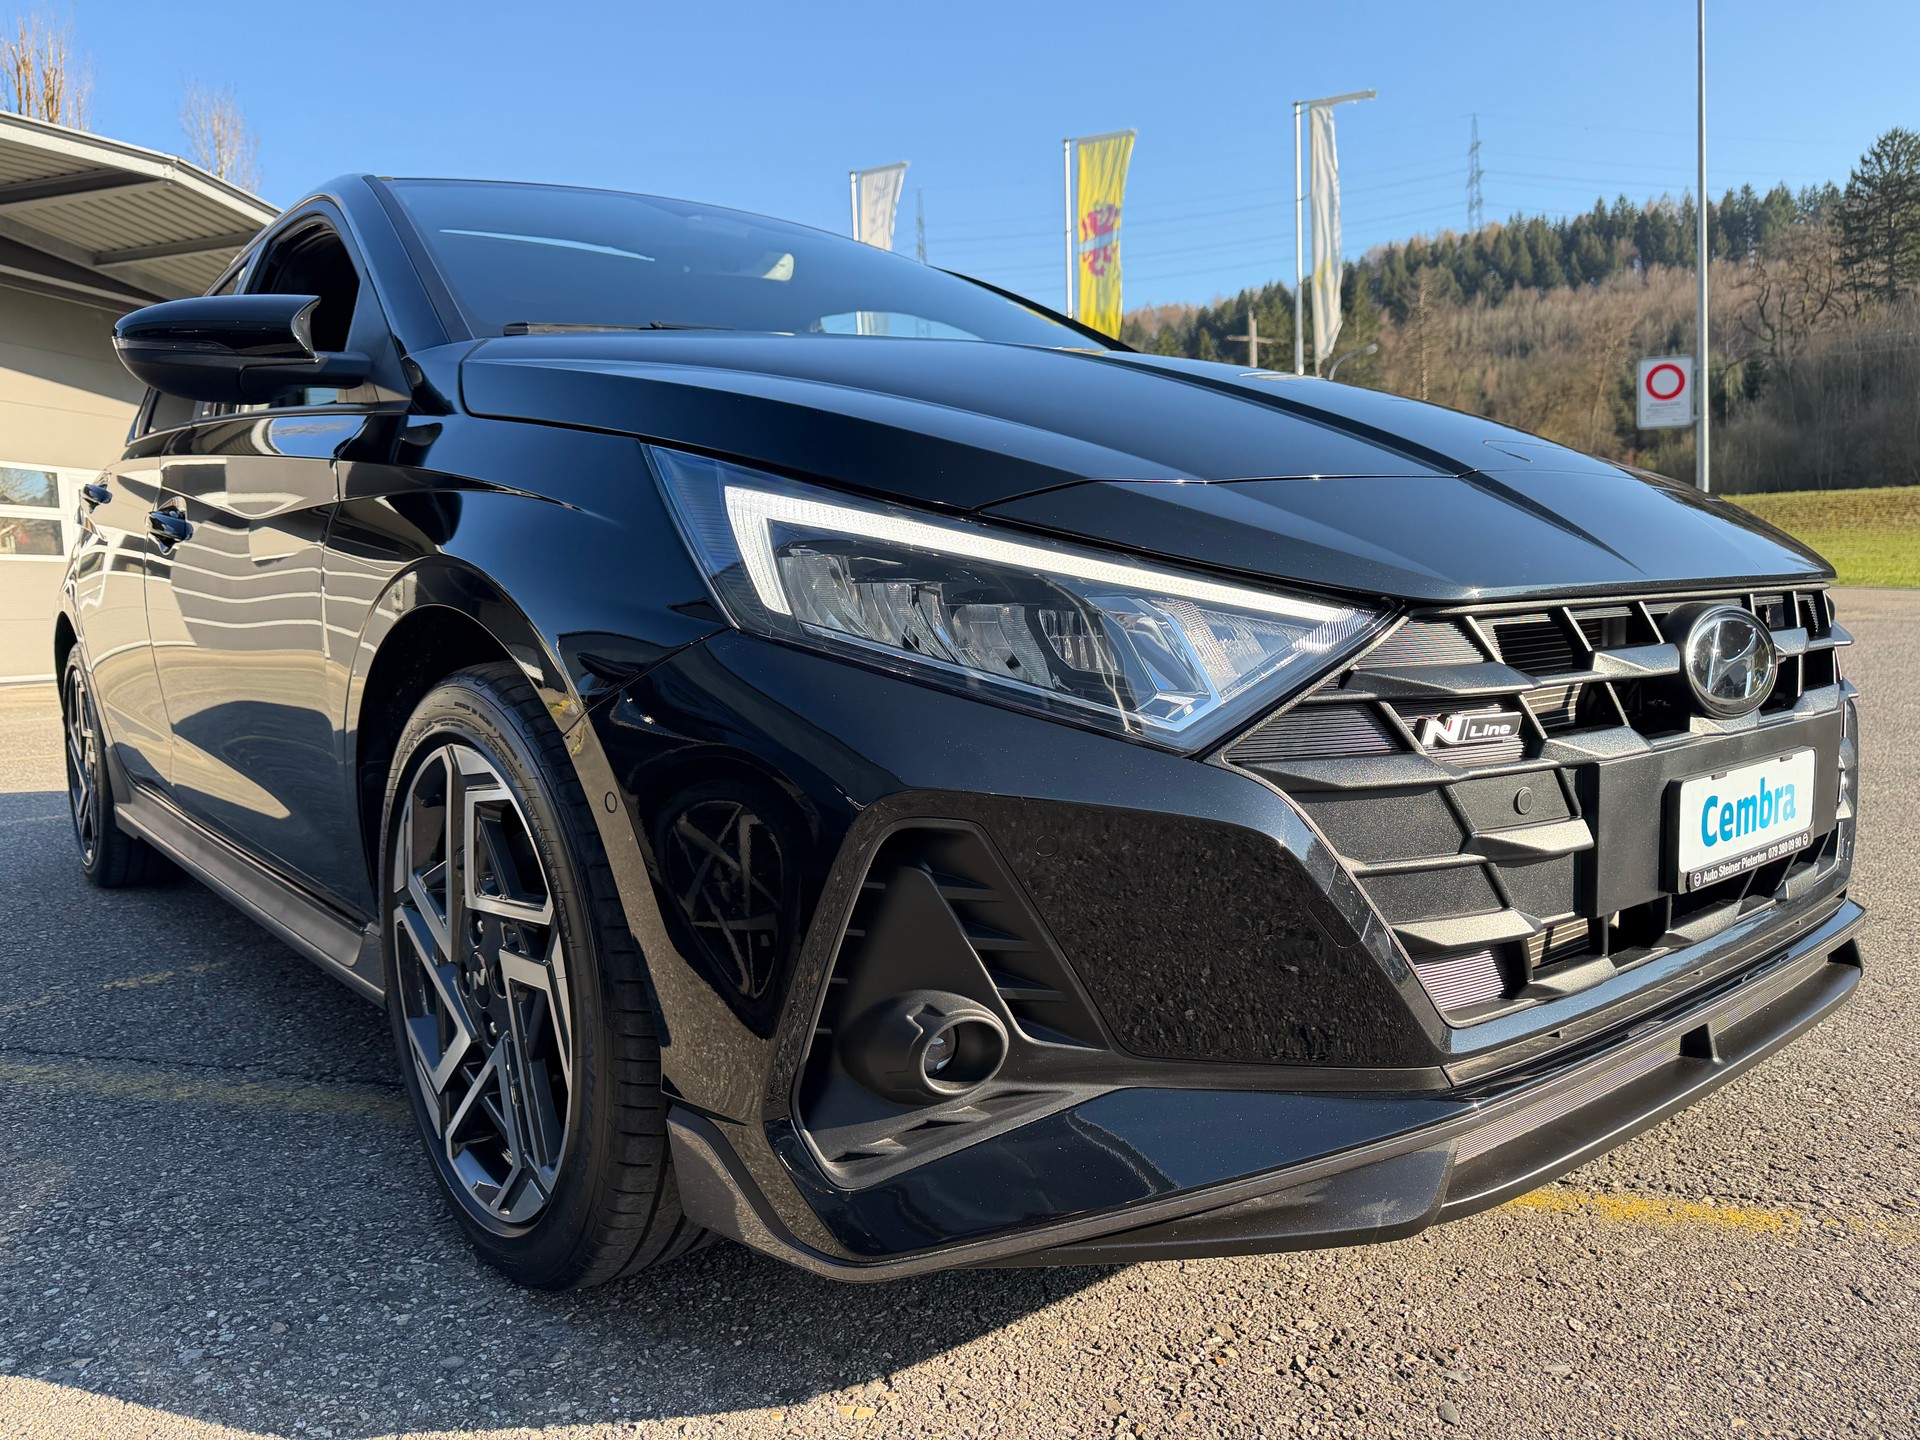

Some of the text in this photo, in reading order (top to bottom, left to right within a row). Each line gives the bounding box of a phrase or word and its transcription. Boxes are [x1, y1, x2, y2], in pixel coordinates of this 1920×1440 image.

[1420, 714, 1511, 746] N Line
[1701, 777, 1796, 847] Cembra
[1702, 869, 1718, 883] Auto
[1718, 862, 1741, 877] Steiner
[1741, 852, 1767, 869] Pieterlen
[1768, 845, 1778, 859] 079
[1788, 839, 1795, 851] 09
[1795, 836, 1802, 849] 90
